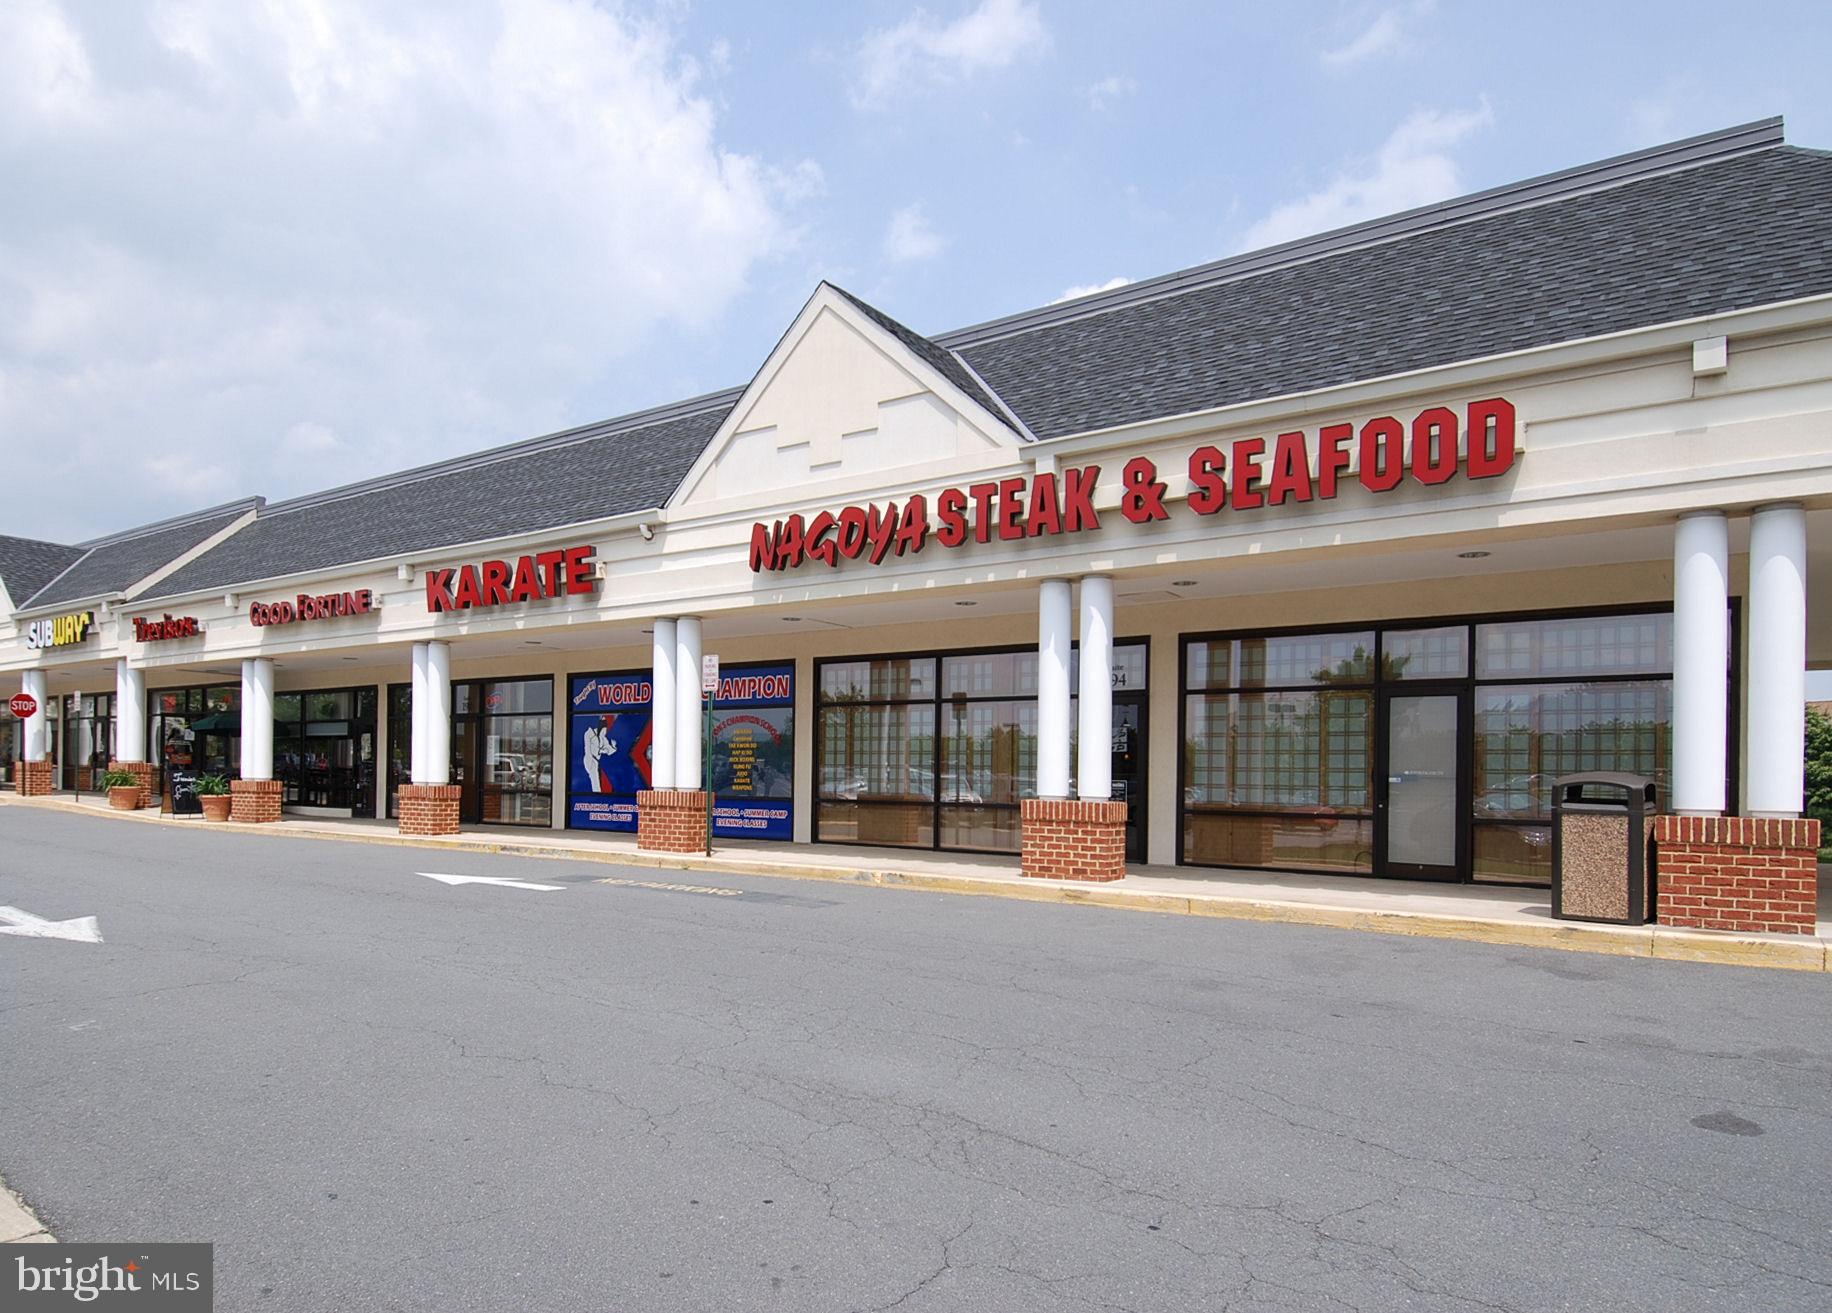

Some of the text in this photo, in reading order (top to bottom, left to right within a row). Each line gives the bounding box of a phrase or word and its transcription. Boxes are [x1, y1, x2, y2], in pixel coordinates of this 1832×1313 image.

[749, 397, 1516, 573] NAGOYA STEAK & SEAFOOD
[425, 545, 597, 613] KARATE
[250, 589, 372, 627] GOOD FORTUNE
[27, 611, 94, 650] SUBWAY
[597, 674, 790, 706] WORLD HAMPION
[1112, 672, 1126, 687] 94
[11, 700, 36, 711] STOP
